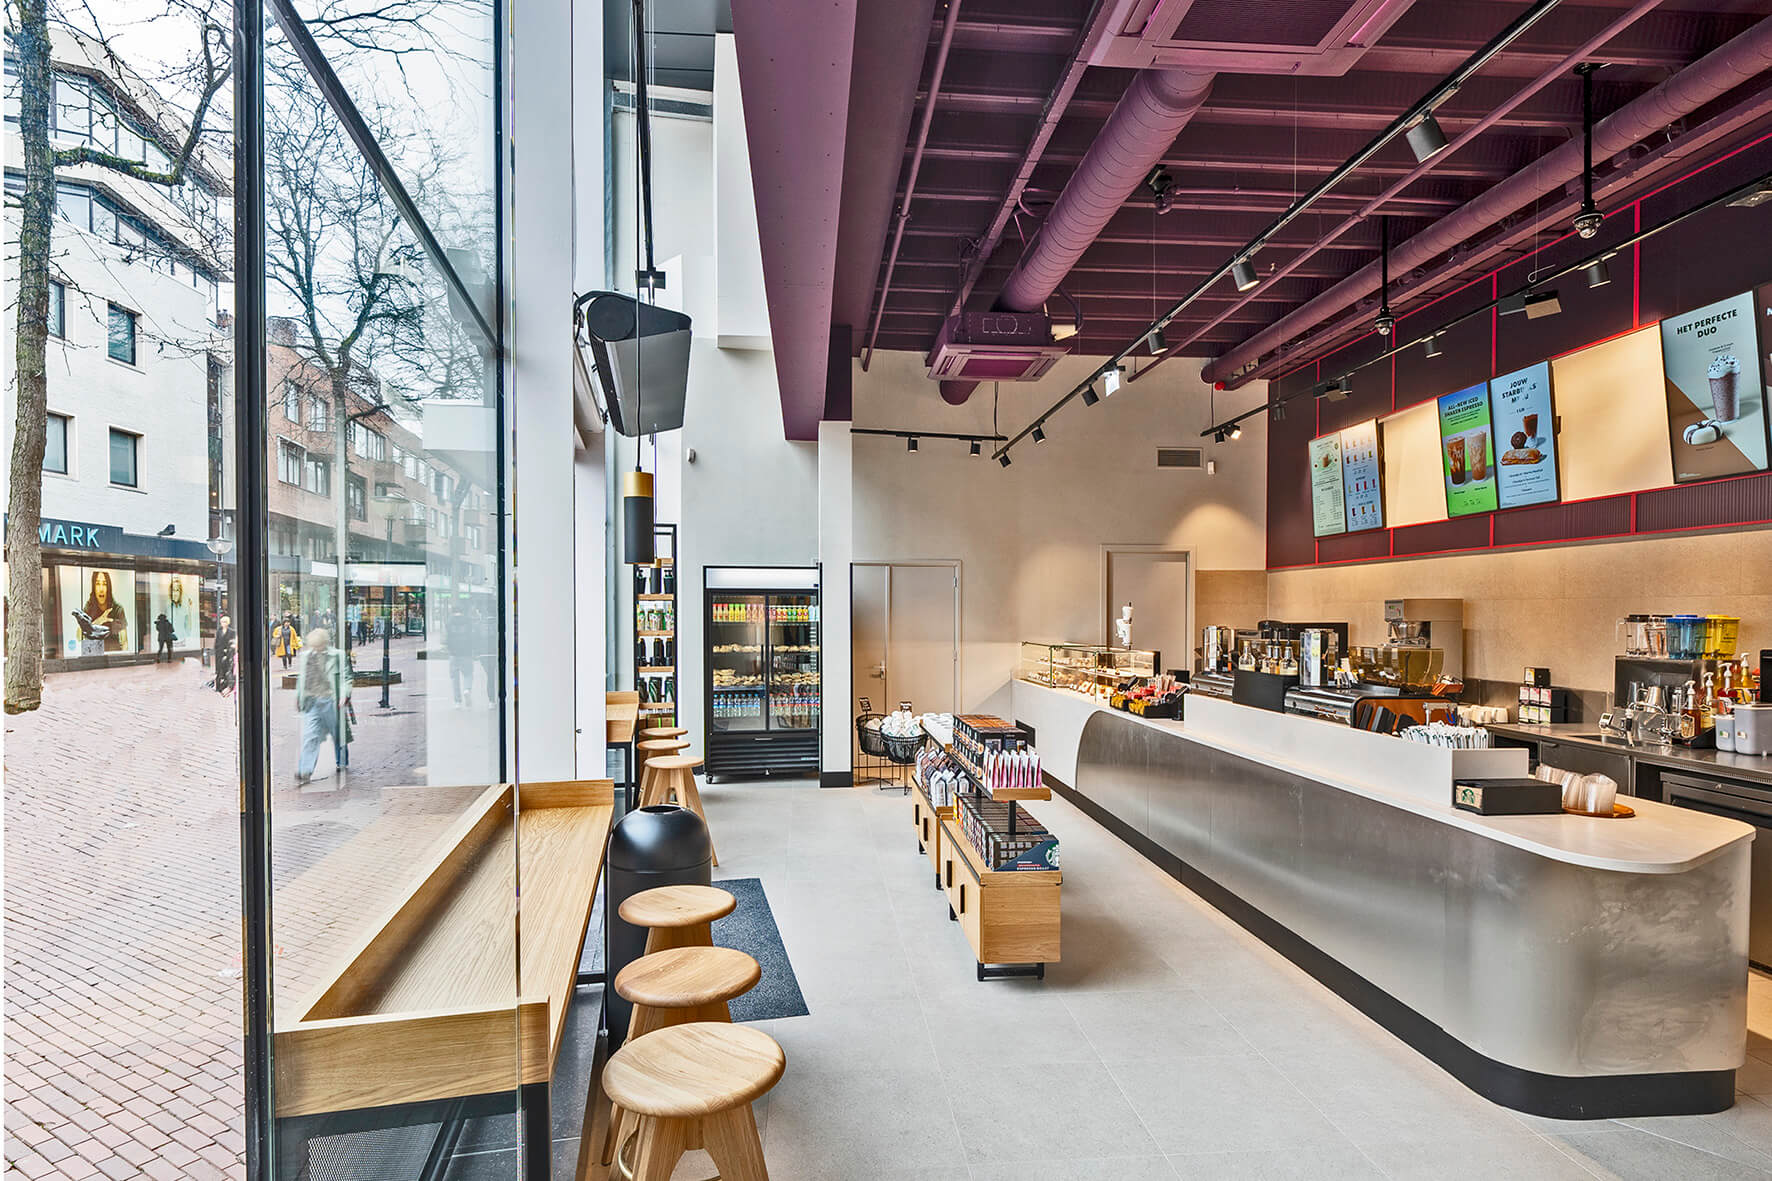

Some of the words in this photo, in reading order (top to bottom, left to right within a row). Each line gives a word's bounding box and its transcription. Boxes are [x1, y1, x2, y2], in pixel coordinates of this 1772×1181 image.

[1676, 324, 1693, 335] HET
[1694, 309, 1738, 329] PERFECTE
[1697, 326, 1718, 338] DUO
[1510, 377, 1528, 389] JOUW
[1502, 383, 1537, 400] STARBS
[1448, 400, 1468, 410] ALL-NEW
[1468, 396, 1479, 404] ICED
[39, 522, 100, 548] MARK
